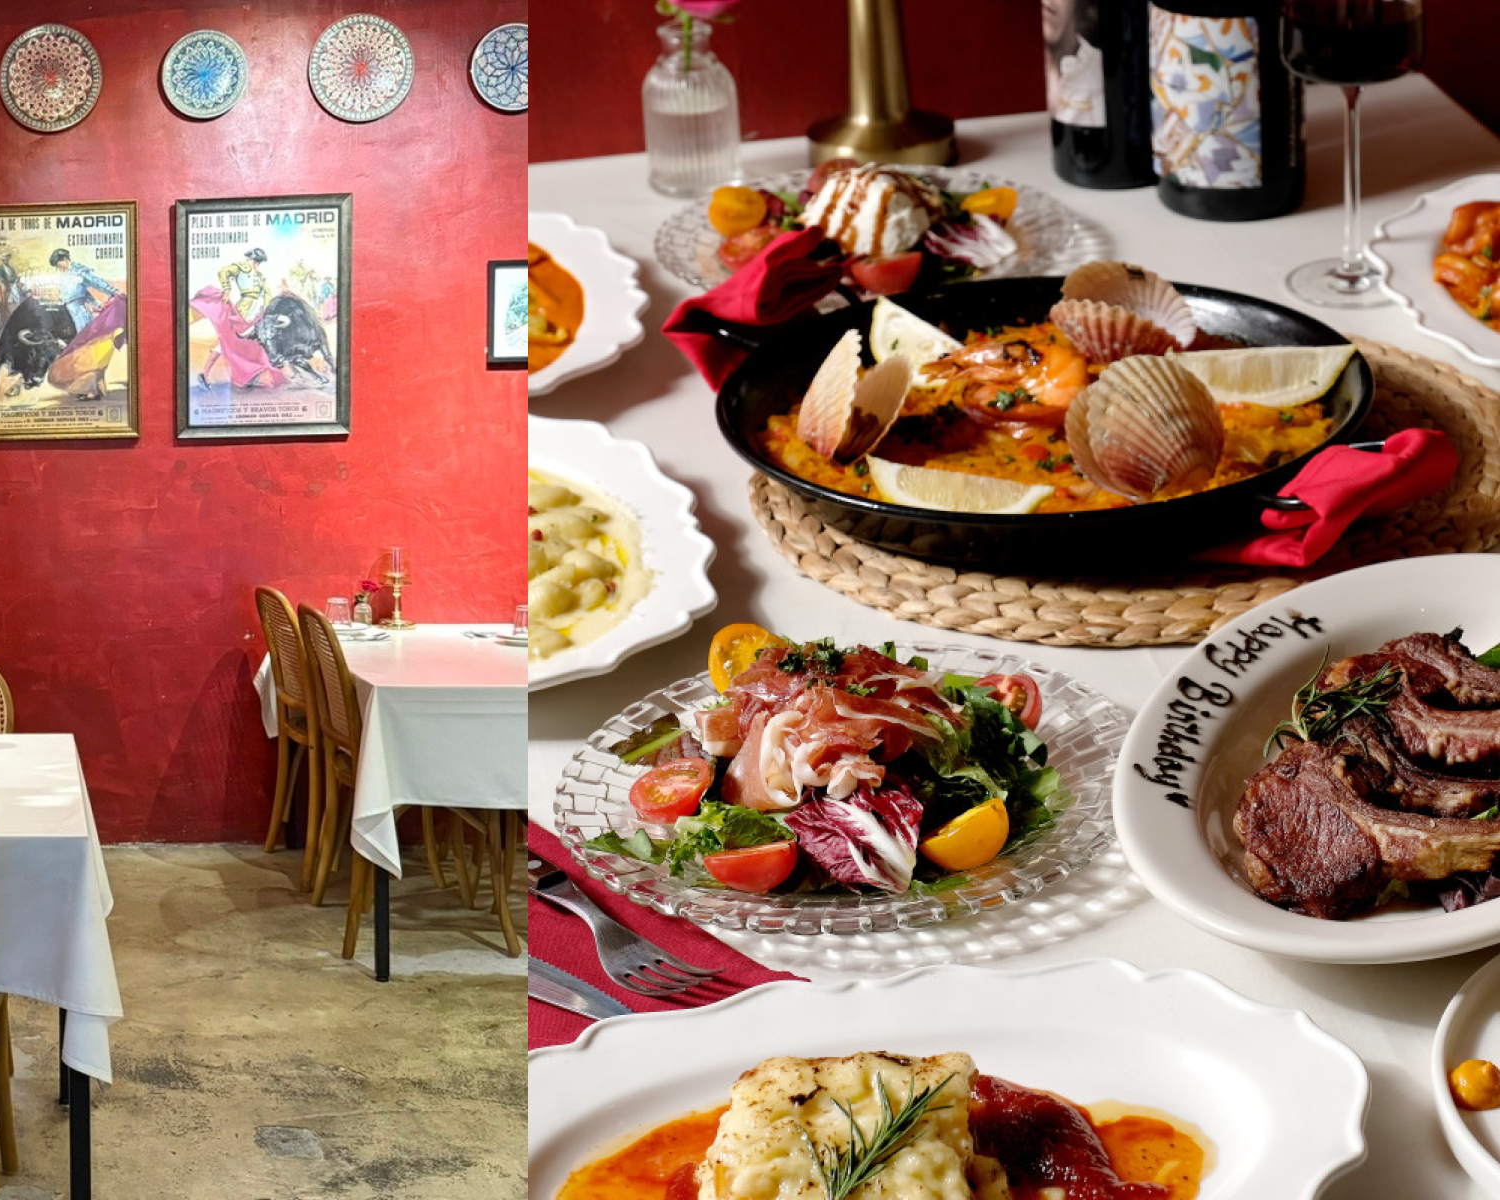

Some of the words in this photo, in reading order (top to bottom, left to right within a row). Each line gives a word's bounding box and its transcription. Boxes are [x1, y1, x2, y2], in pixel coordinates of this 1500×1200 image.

[8, 217, 16, 230] DE
[21, 217, 40, 230] TOROS
[44, 216, 52, 229] DE
[56, 215, 124, 229] MADRID
[191, 216, 212, 229] PLAZA
[216, 215, 224, 228] DE
[229, 214, 249, 227] TOROS
[253, 214, 261, 227] DE
[266, 211, 335, 226] MADRID
[67, 233, 124, 247] EXTRAORDINARIA
[191, 231, 249, 245] EXTRAORDINARIA
[95, 247, 124, 260] CORRIDA
[191, 247, 220, 259] CORRIDA
[1203, 614, 1325, 678] Happy
[1134, 676, 1235, 789] Birthday
